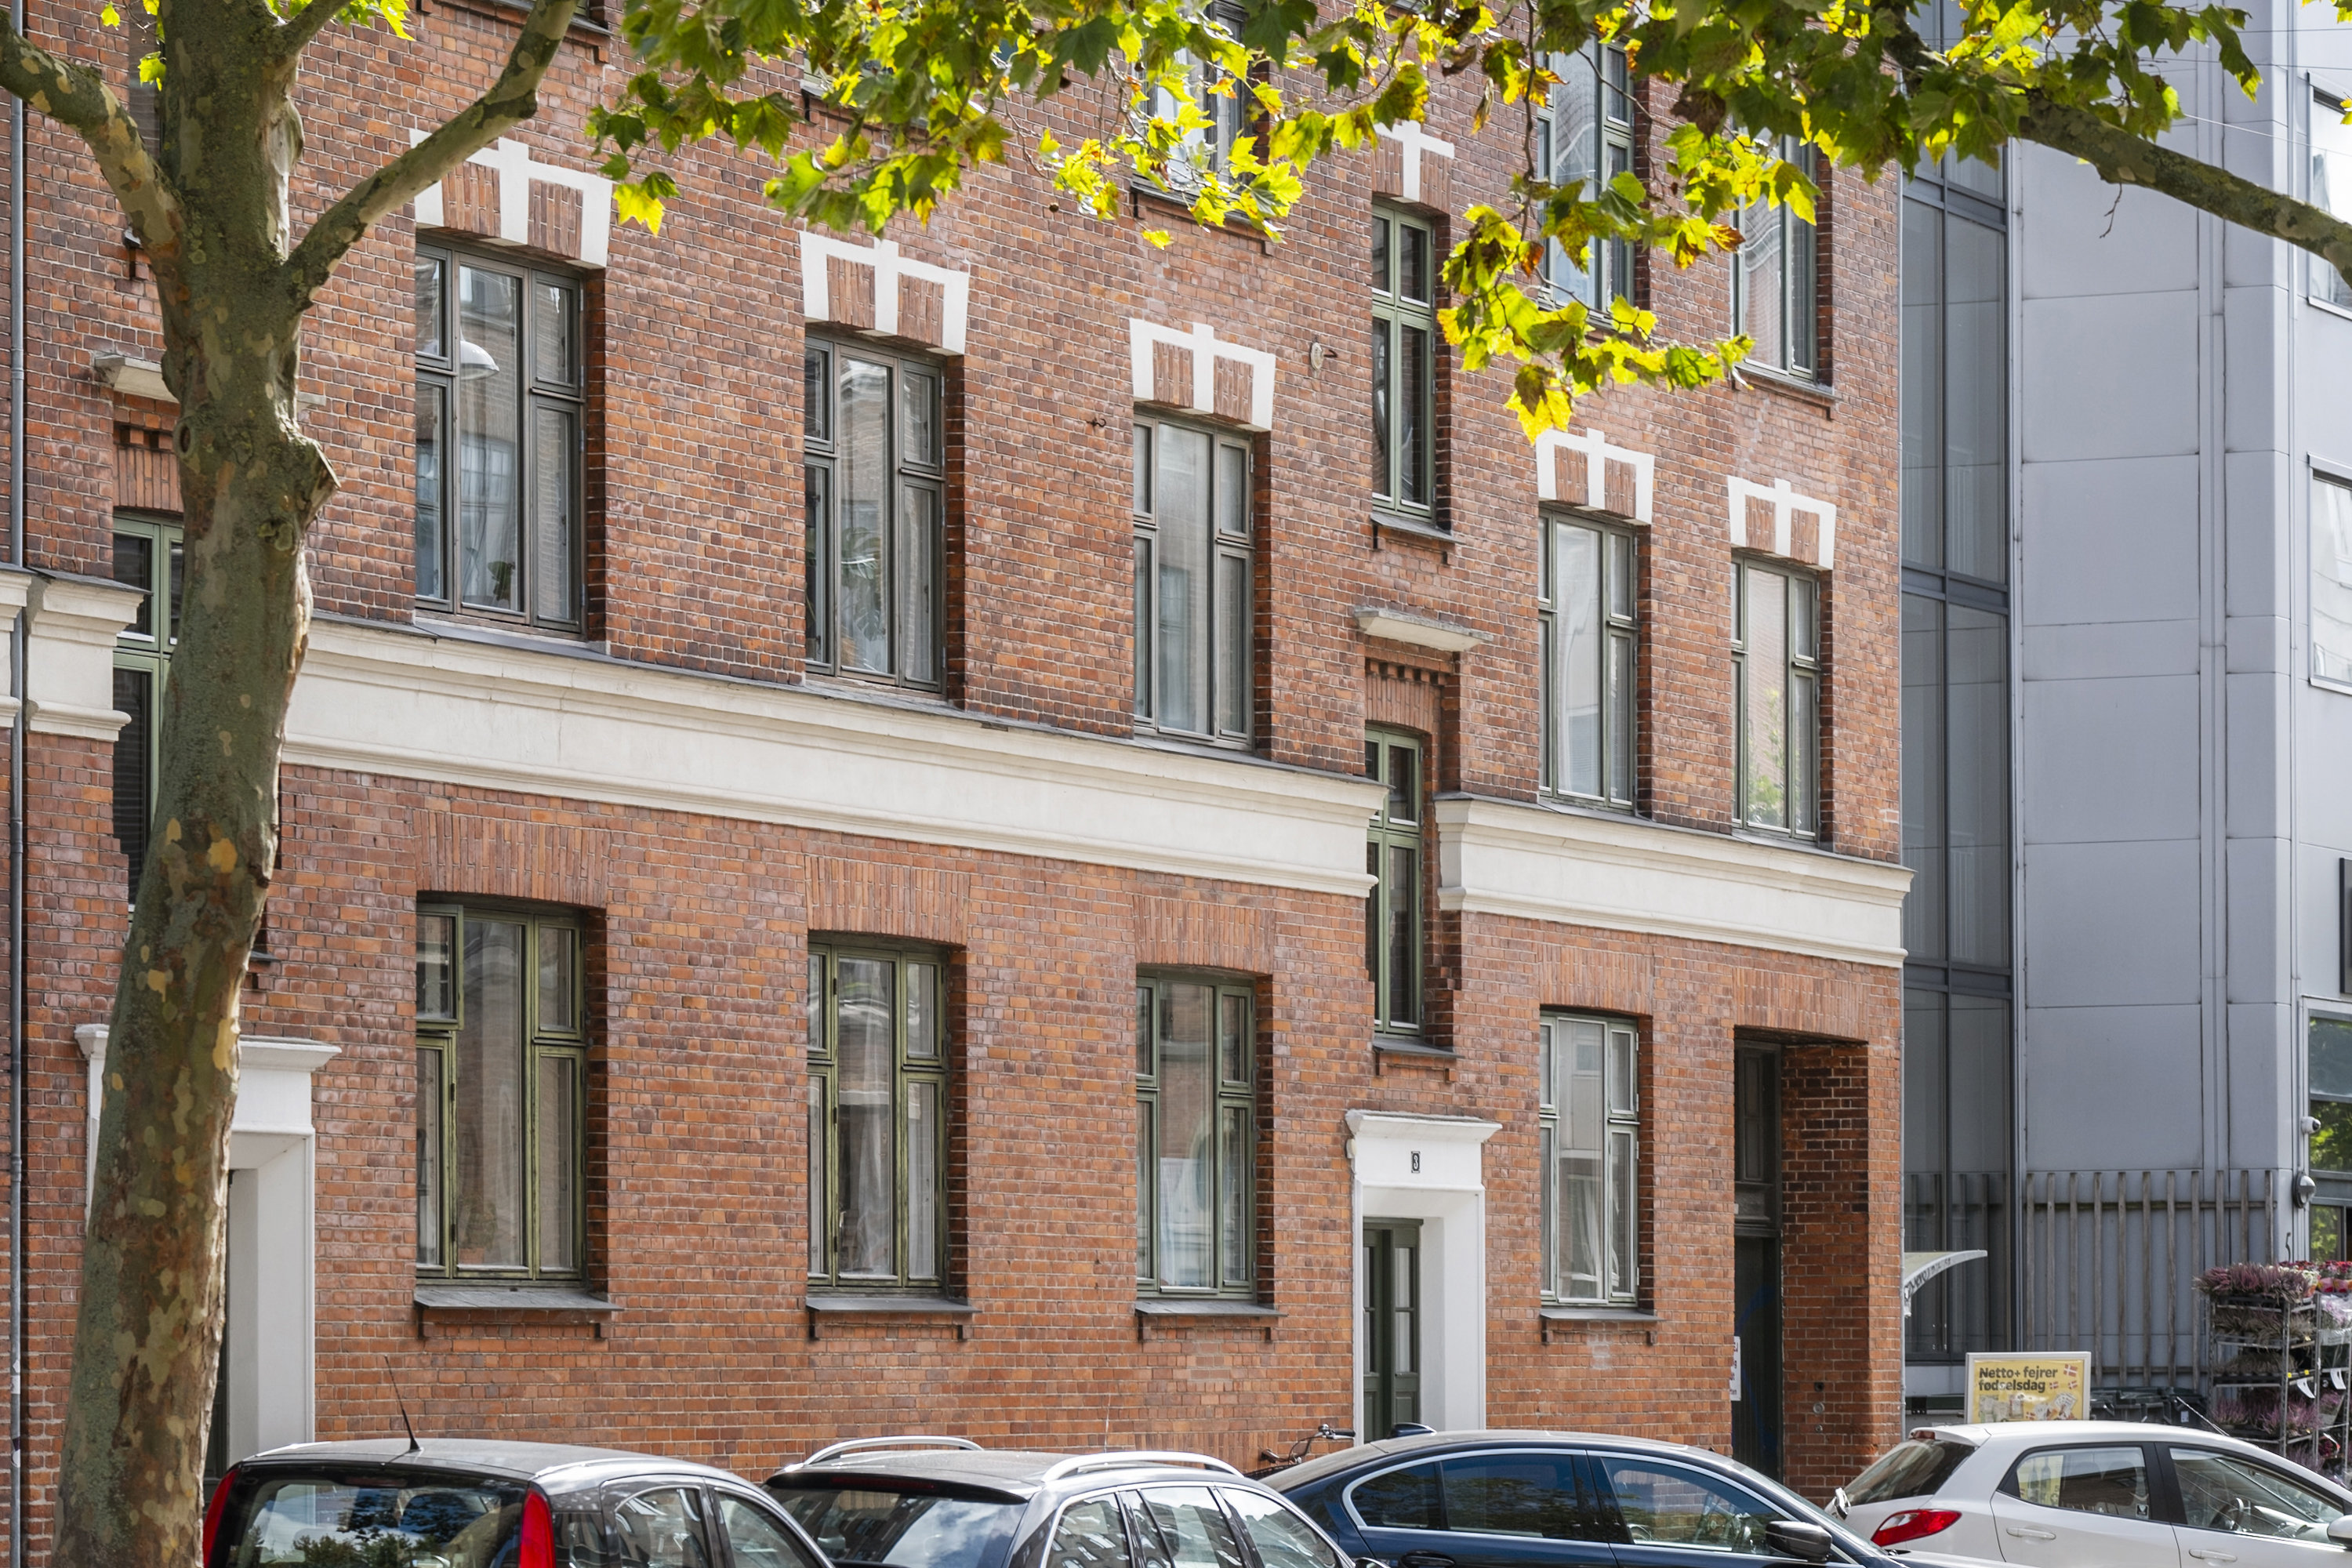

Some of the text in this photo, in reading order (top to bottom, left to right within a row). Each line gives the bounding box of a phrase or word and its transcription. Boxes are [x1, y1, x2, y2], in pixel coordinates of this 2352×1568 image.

[1413, 1154, 1419, 1170] 3
[1980, 1365, 2058, 1380] Netto+ fejrer
